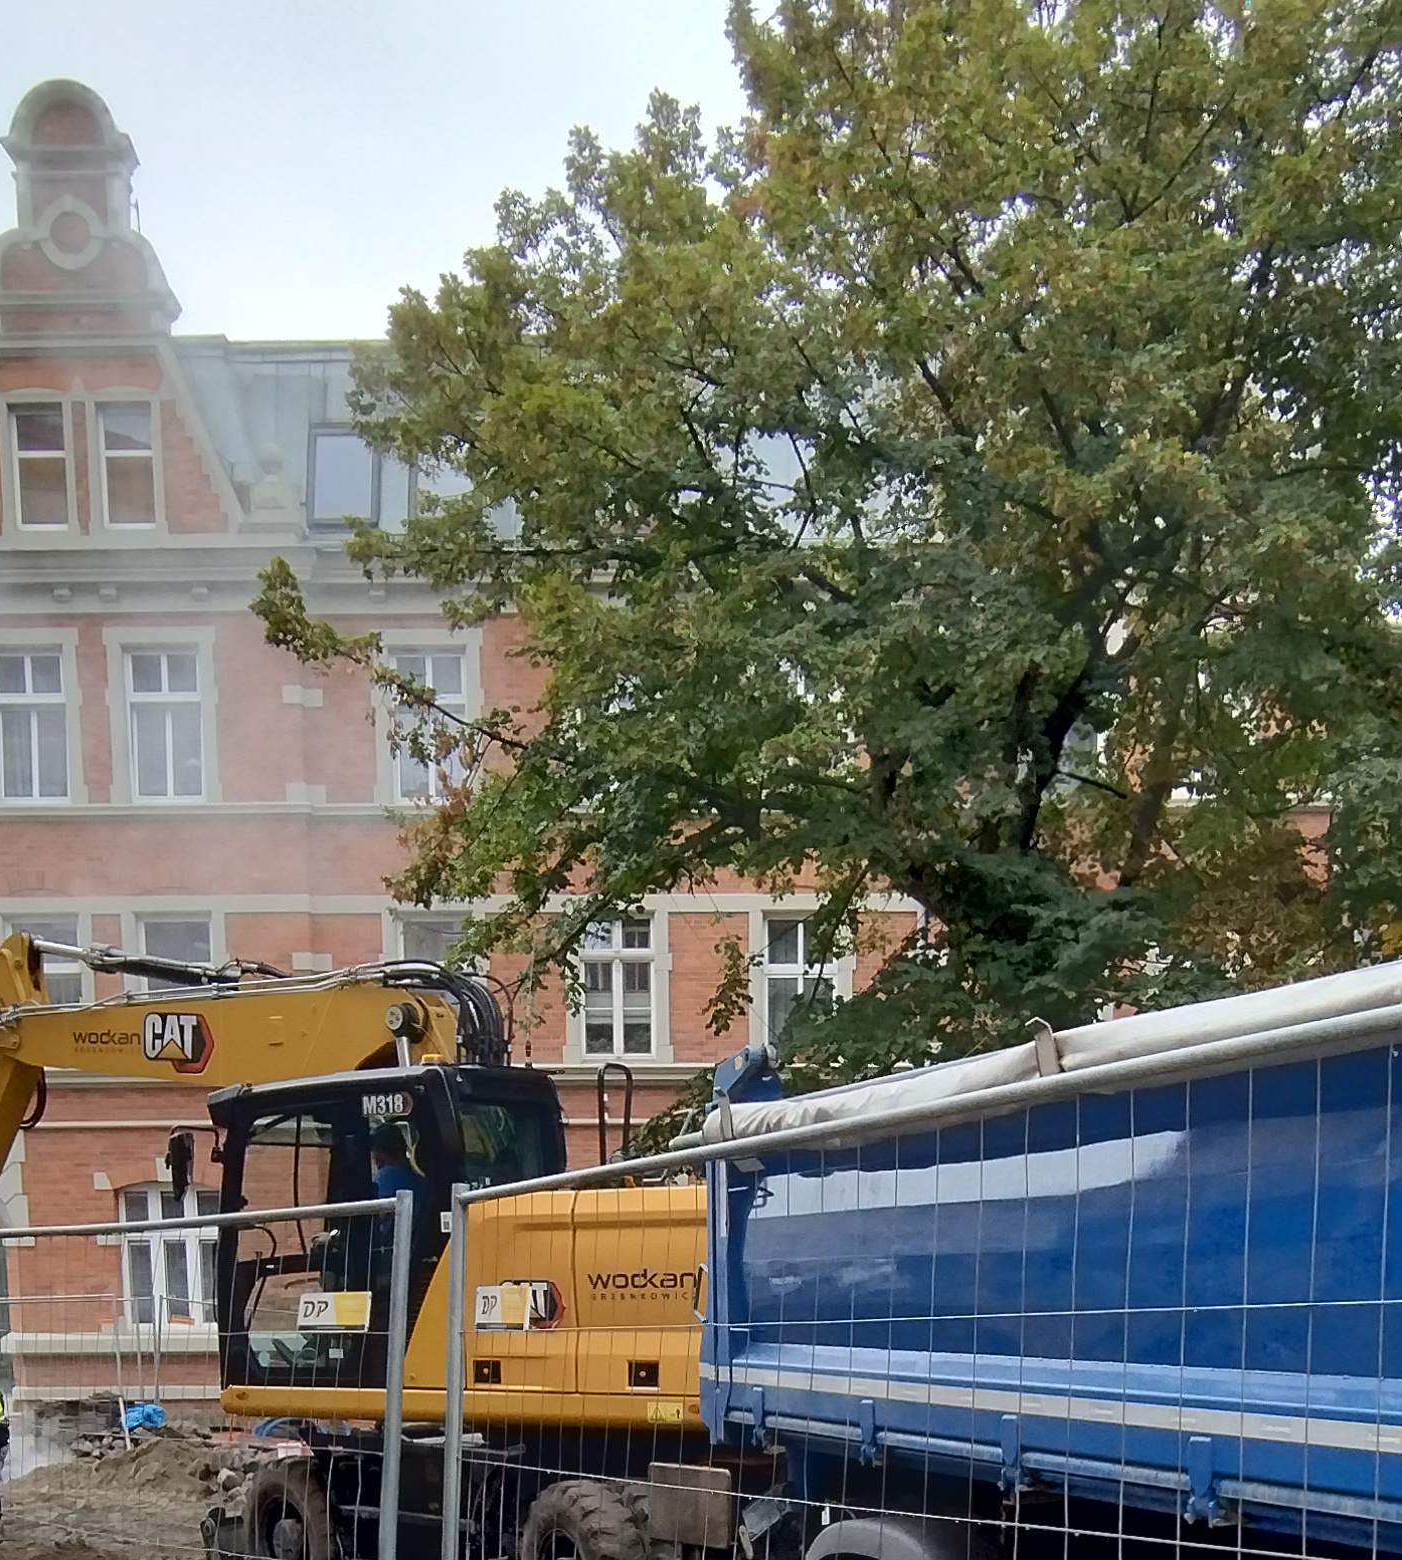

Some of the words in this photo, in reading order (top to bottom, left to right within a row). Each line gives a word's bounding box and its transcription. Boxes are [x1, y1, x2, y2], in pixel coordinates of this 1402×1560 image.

[145, 1013, 198, 1060] CAT
[362, 1093, 404, 1115] M318
[303, 1300, 329, 1318] DP
[481, 1295, 498, 1317] DP
